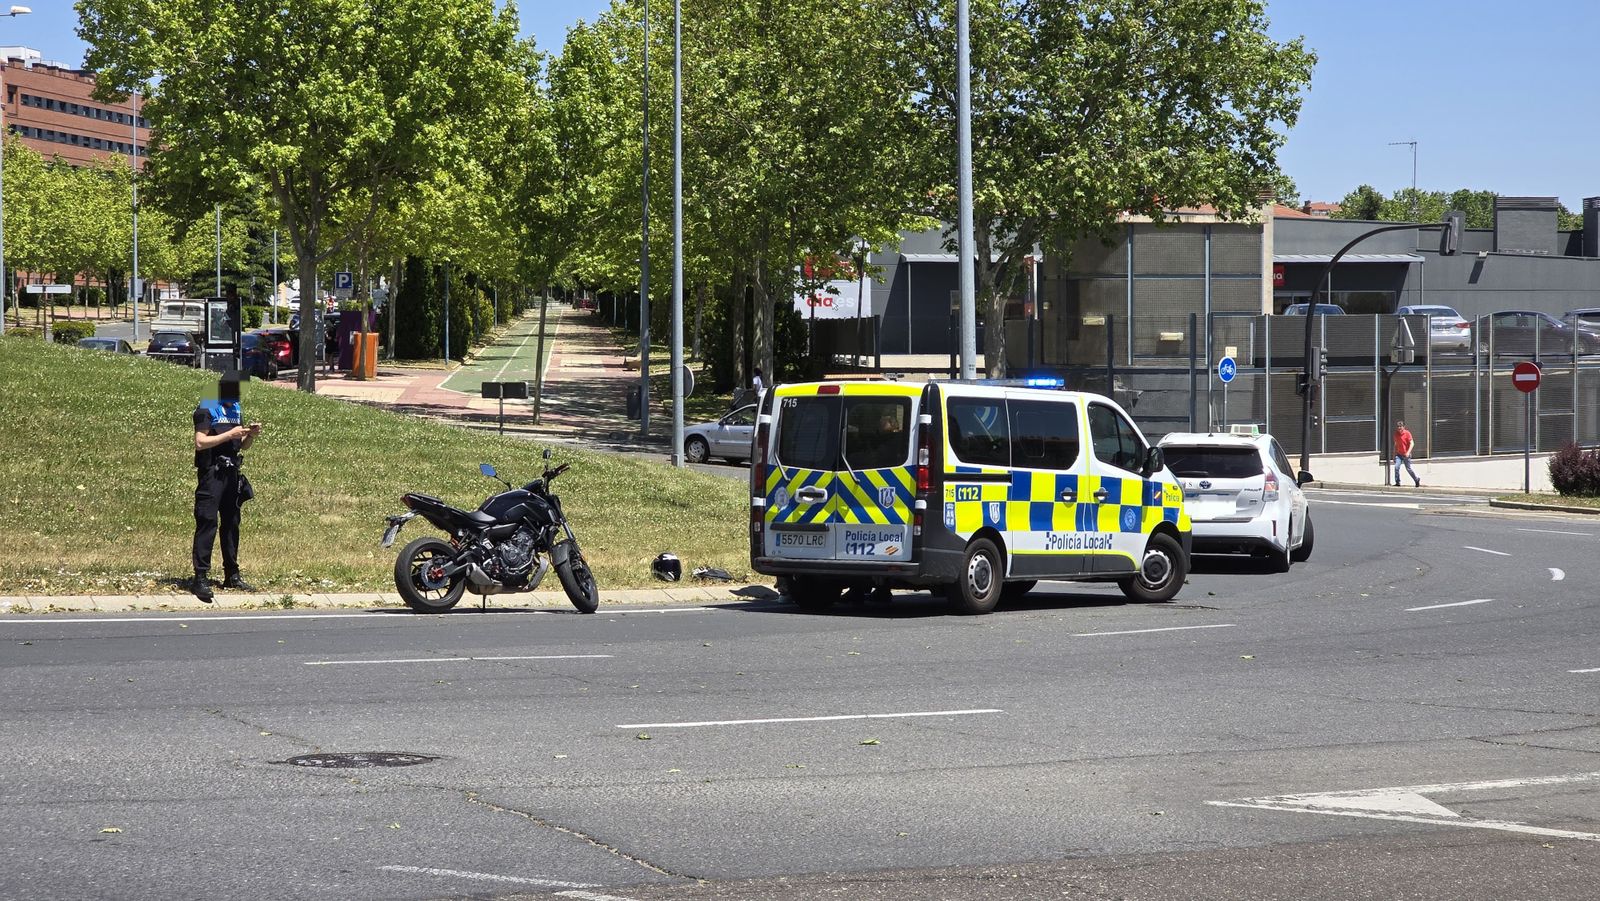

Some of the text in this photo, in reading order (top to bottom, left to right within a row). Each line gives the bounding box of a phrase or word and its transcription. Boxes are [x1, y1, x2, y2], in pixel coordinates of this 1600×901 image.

[338, 274, 349, 287] P
[782, 398, 798, 408] 715
[945, 488, 954, 498] 715
[781, 534, 824, 546] 5570 LRC
[879, 531, 903, 542] Local
[1051, 533, 1107, 550] Policía Local
